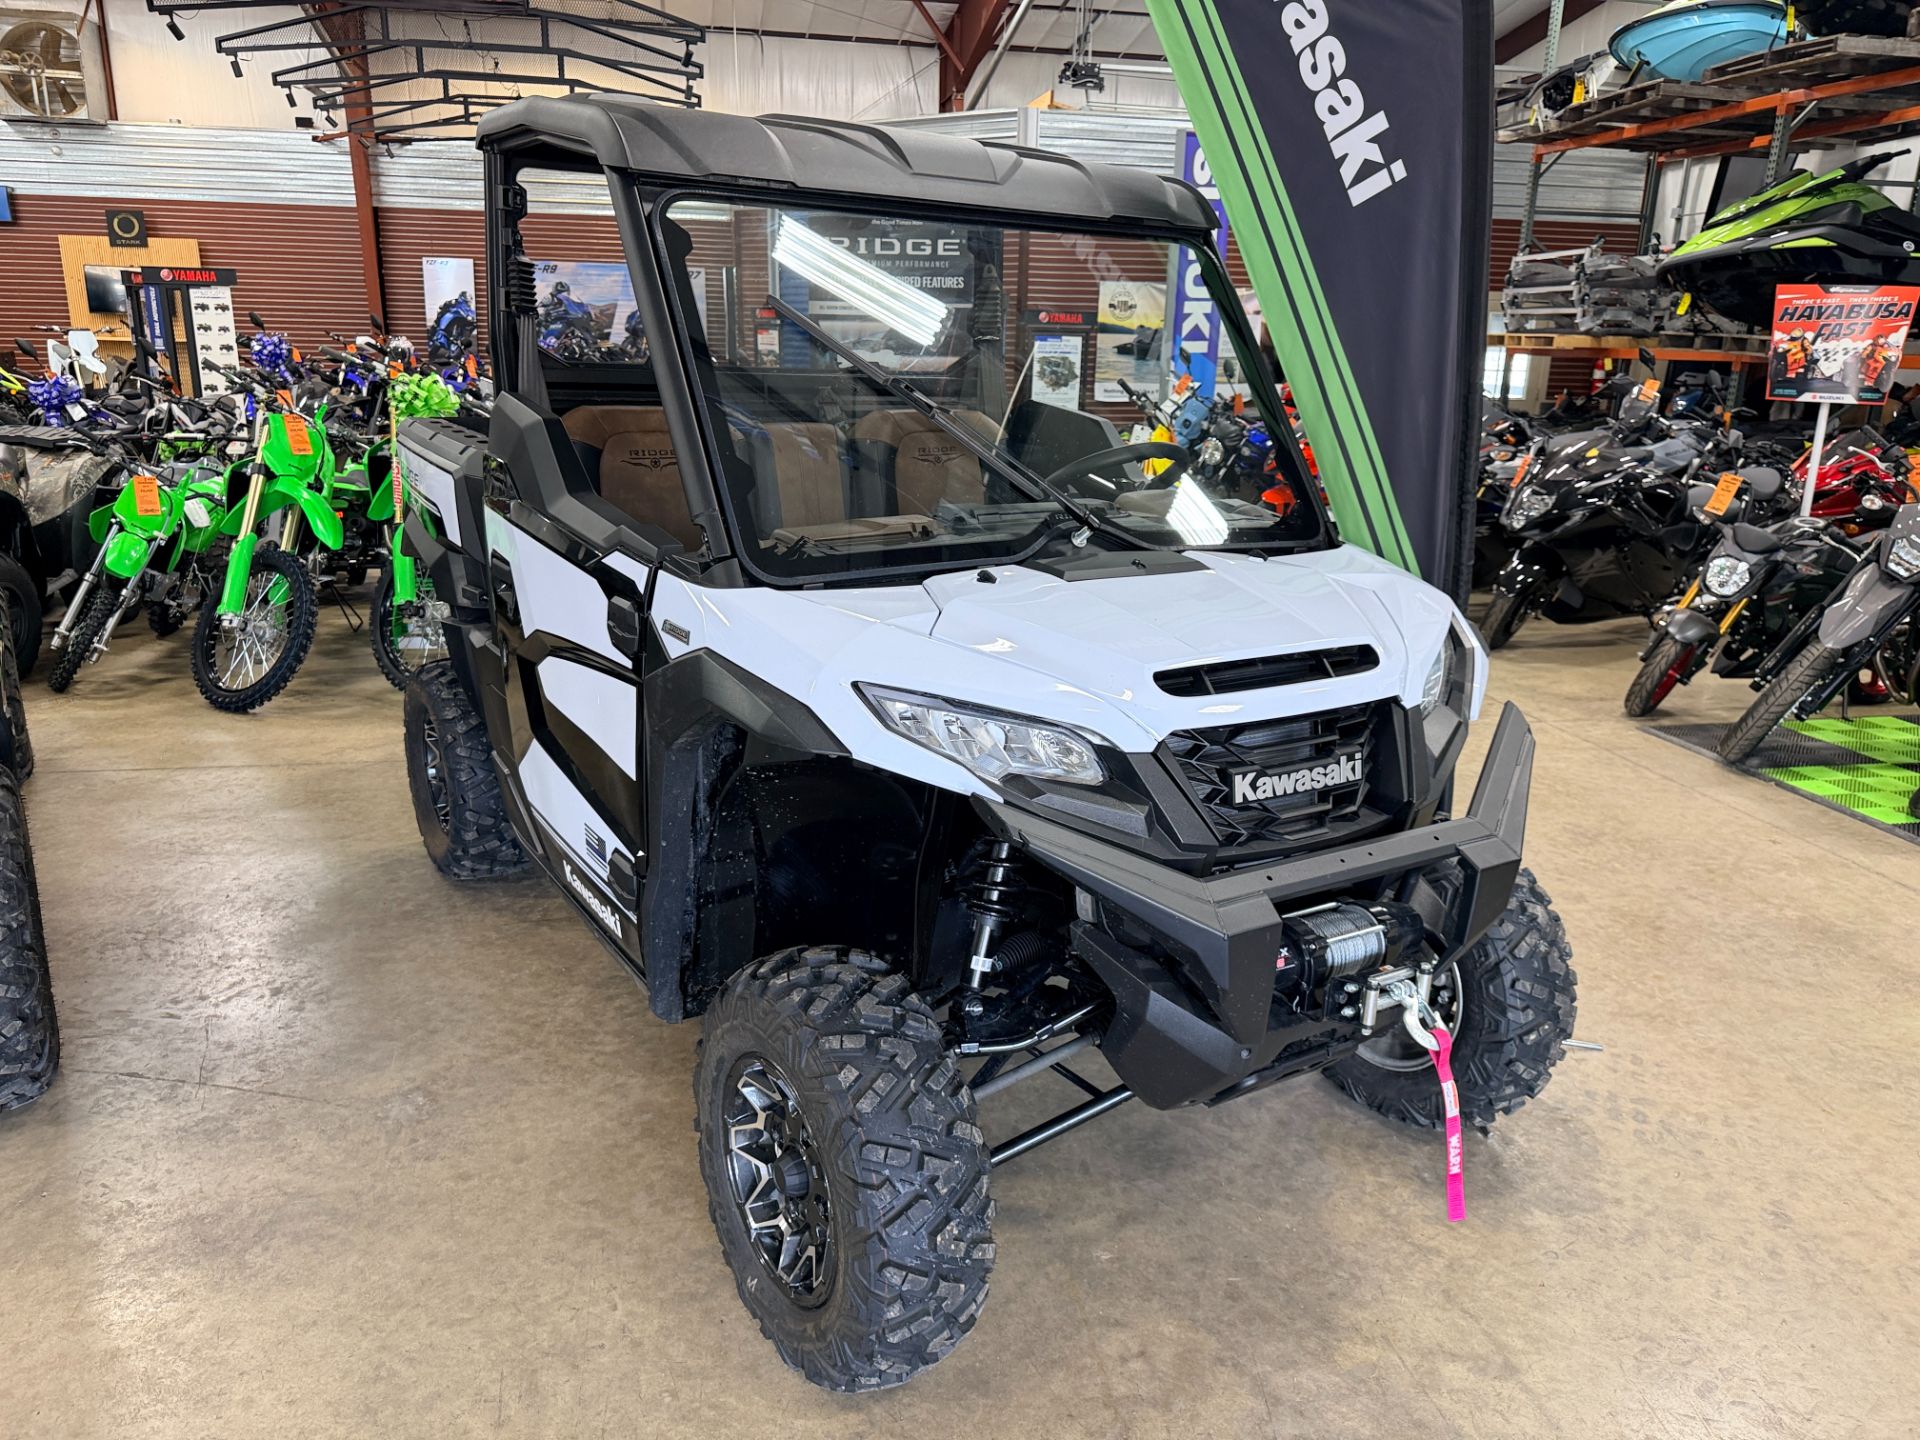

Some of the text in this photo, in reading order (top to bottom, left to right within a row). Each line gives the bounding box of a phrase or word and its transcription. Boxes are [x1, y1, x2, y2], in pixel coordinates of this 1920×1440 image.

[1280, 0, 1408, 207] asaki
[1180, 147, 1222, 354] SUKI
[173, 269, 217, 282] YAMAHA
[895, 260, 949, 269] PERFORMANCE
[922, 276, 965, 289] FEATURES
[1048, 312, 1083, 324] YAMAHA
[1777, 302, 1914, 322] HAYABUSA
[1812, 321, 1873, 344] FAST
[1234, 752, 1363, 804] Kawasaki
[563, 859, 622, 939] Kawasaki
[1448, 1132, 1462, 1175] WARN
